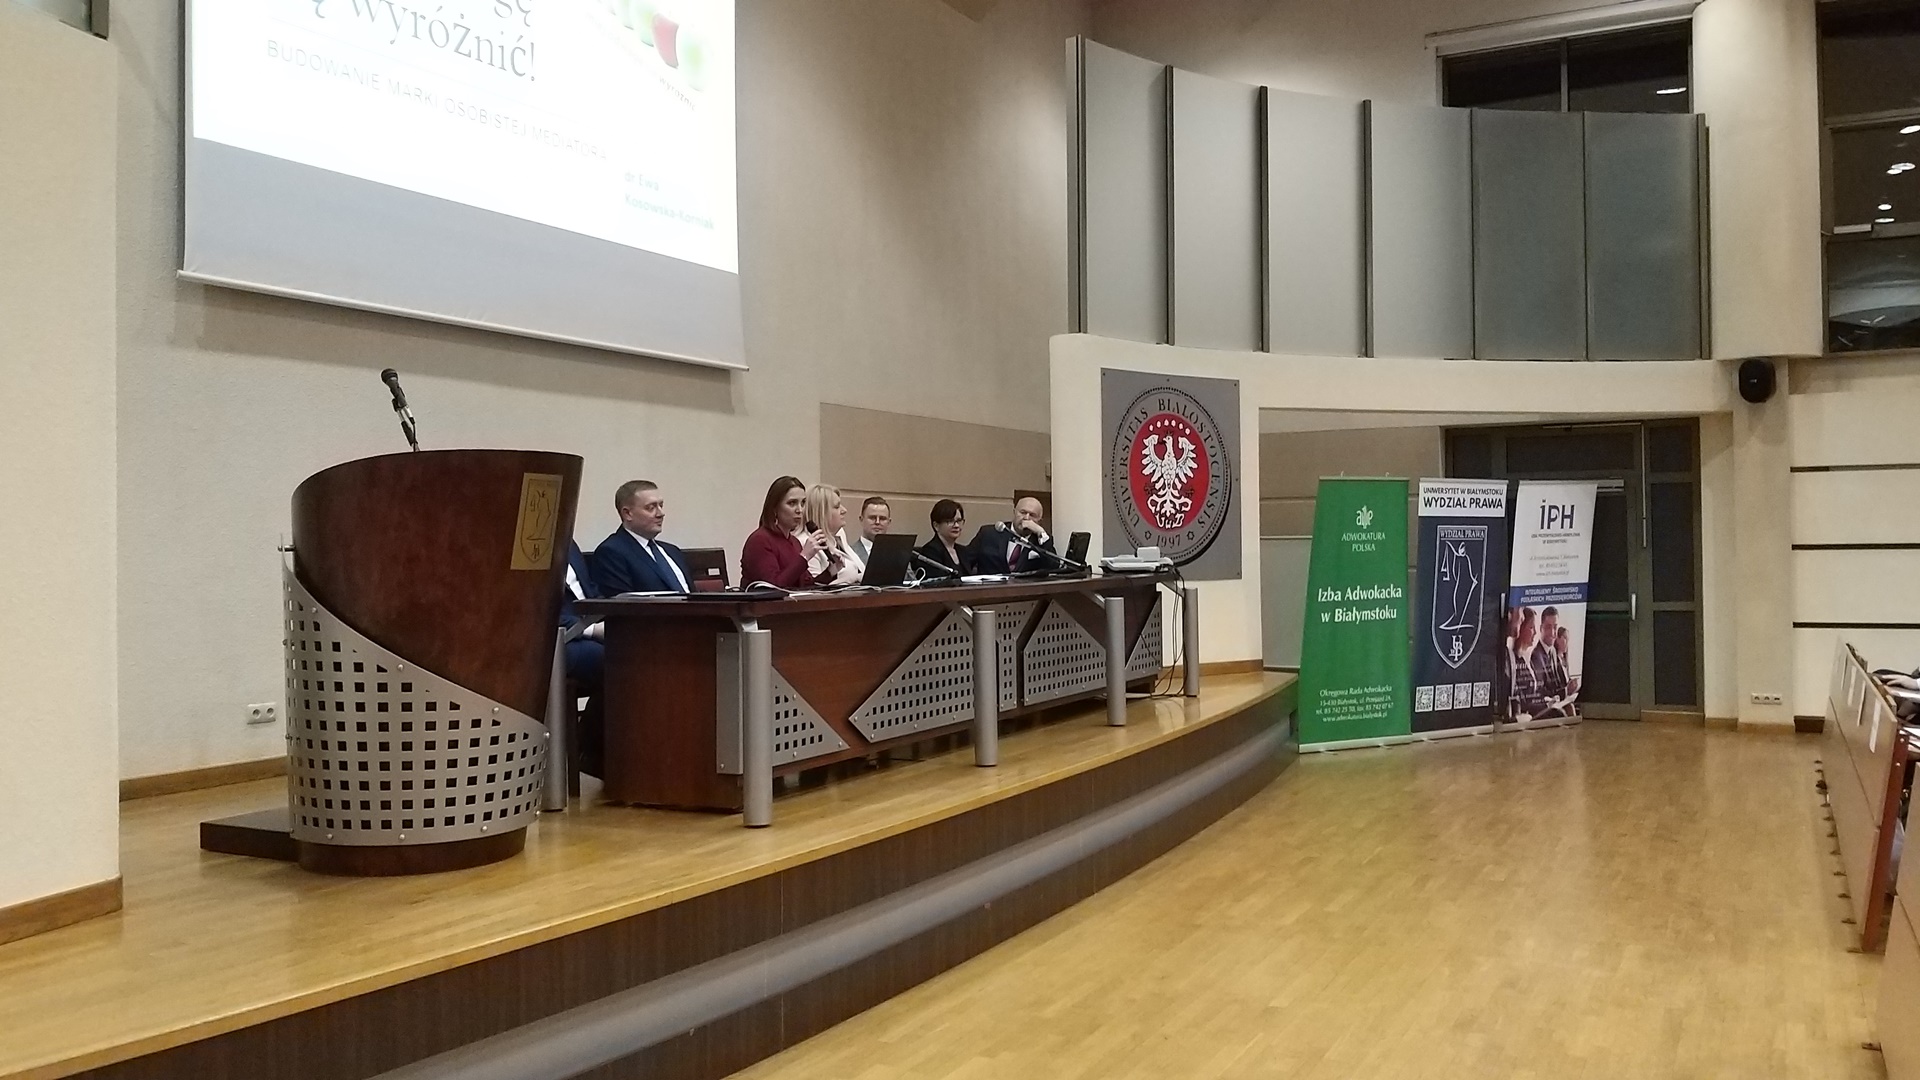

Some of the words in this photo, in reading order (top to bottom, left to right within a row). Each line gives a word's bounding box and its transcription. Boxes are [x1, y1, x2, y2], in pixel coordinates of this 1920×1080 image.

[267, 39, 380, 91] BUDOWANIE
[388, 78, 438, 109] MARKI
[444, 98, 528, 138] OSOBISTEJ
[532, 126, 608, 162] MEDIATORA
[638, 173, 660, 192] Ewa
[1118, 407, 1149, 529] UNIVERSITAS
[1460, 487, 1467, 495] W
[1467, 488, 1504, 496] BIAŁYMSTOKU
[1423, 496, 1467, 508] WYDZIAŁ
[1469, 497, 1504, 509] PRAWA
[1156, 533, 1181, 550] 1997
[1341, 532, 1386, 541] ADWOKATURA
[1465, 529, 1485, 538] PRAWA
[1352, 543, 1376, 552] POLSKA
[1318, 586, 1342, 602] Izba
[1344, 583, 1402, 601] Adwokacka
[1321, 612, 1331, 623] w
[1334, 604, 1397, 625] Białymstoku
